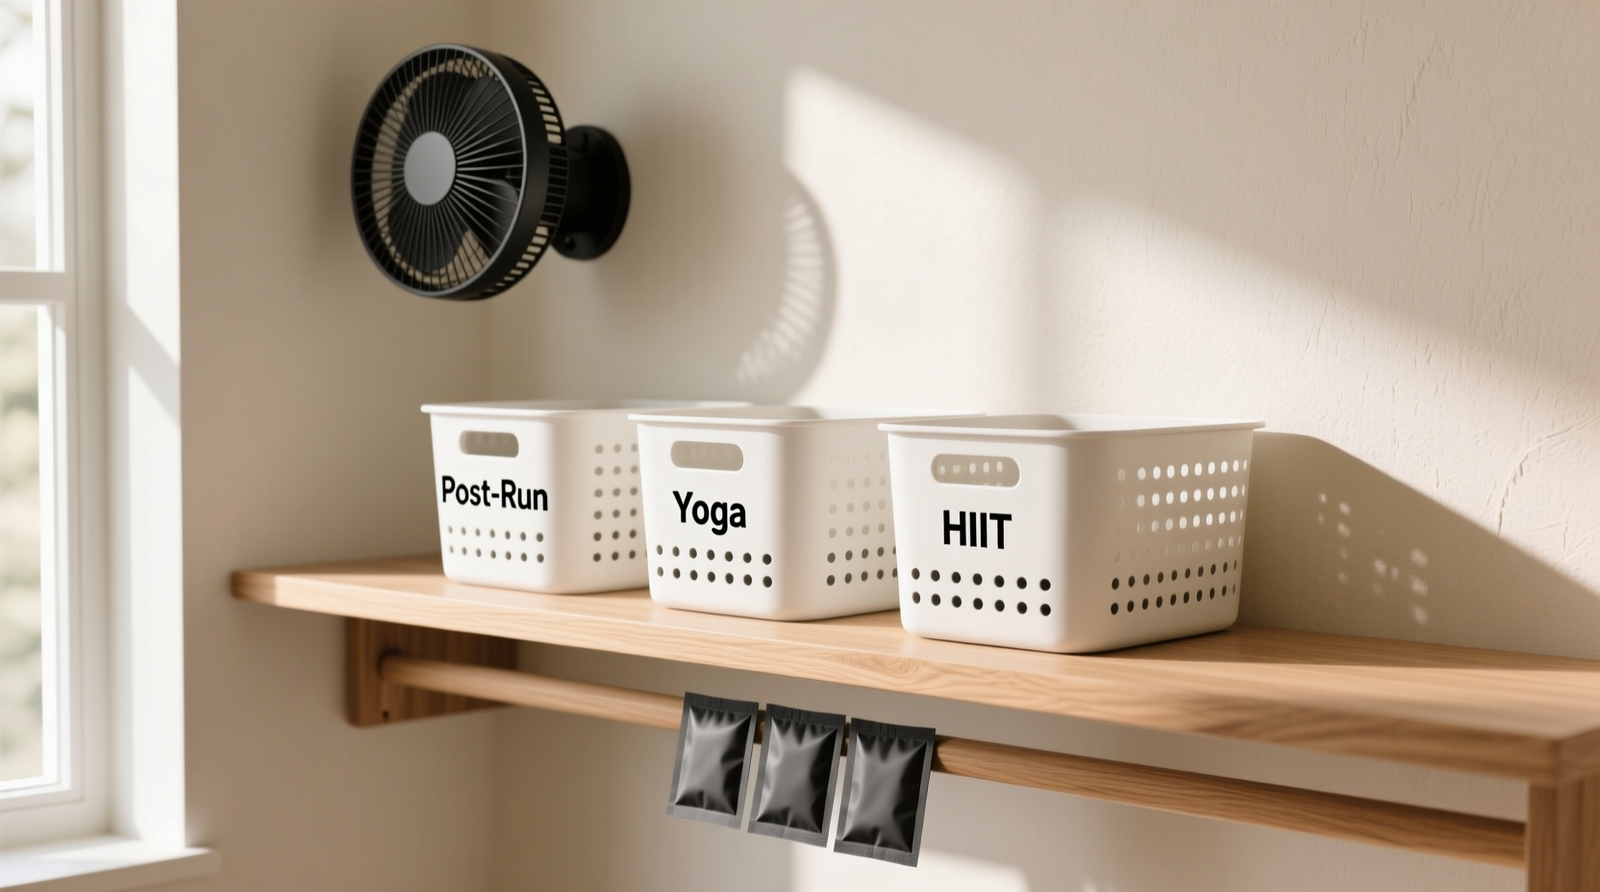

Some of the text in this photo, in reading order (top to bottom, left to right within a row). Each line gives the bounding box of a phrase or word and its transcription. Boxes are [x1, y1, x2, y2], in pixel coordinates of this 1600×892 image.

[441, 475, 549, 512] Post-Run
[672, 490, 747, 536] Yoga
[943, 509, 1013, 550] HIIT
